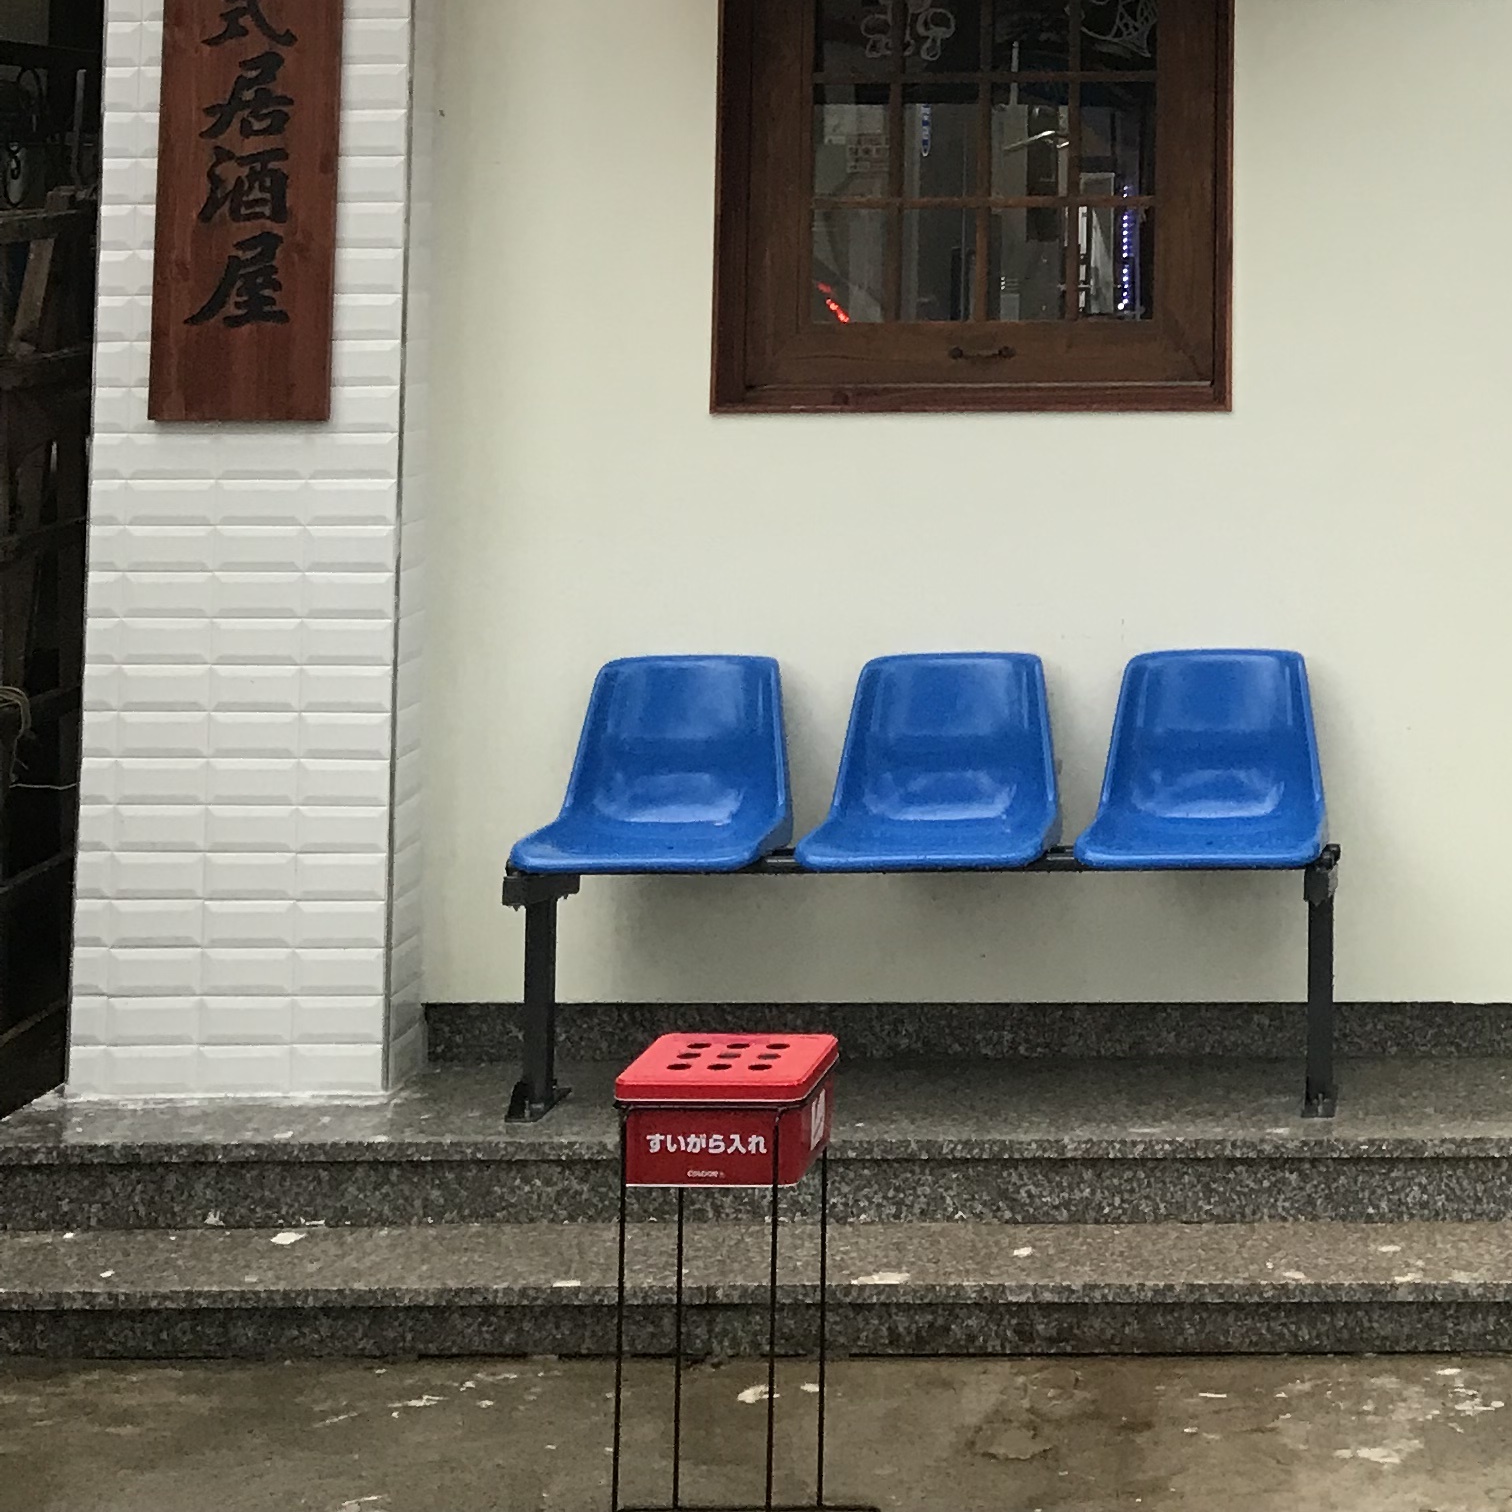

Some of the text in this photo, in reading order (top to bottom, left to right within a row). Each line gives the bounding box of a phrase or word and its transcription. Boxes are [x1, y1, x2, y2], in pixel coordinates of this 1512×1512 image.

[646, 1133, 768, 1155] すいがら入れ
